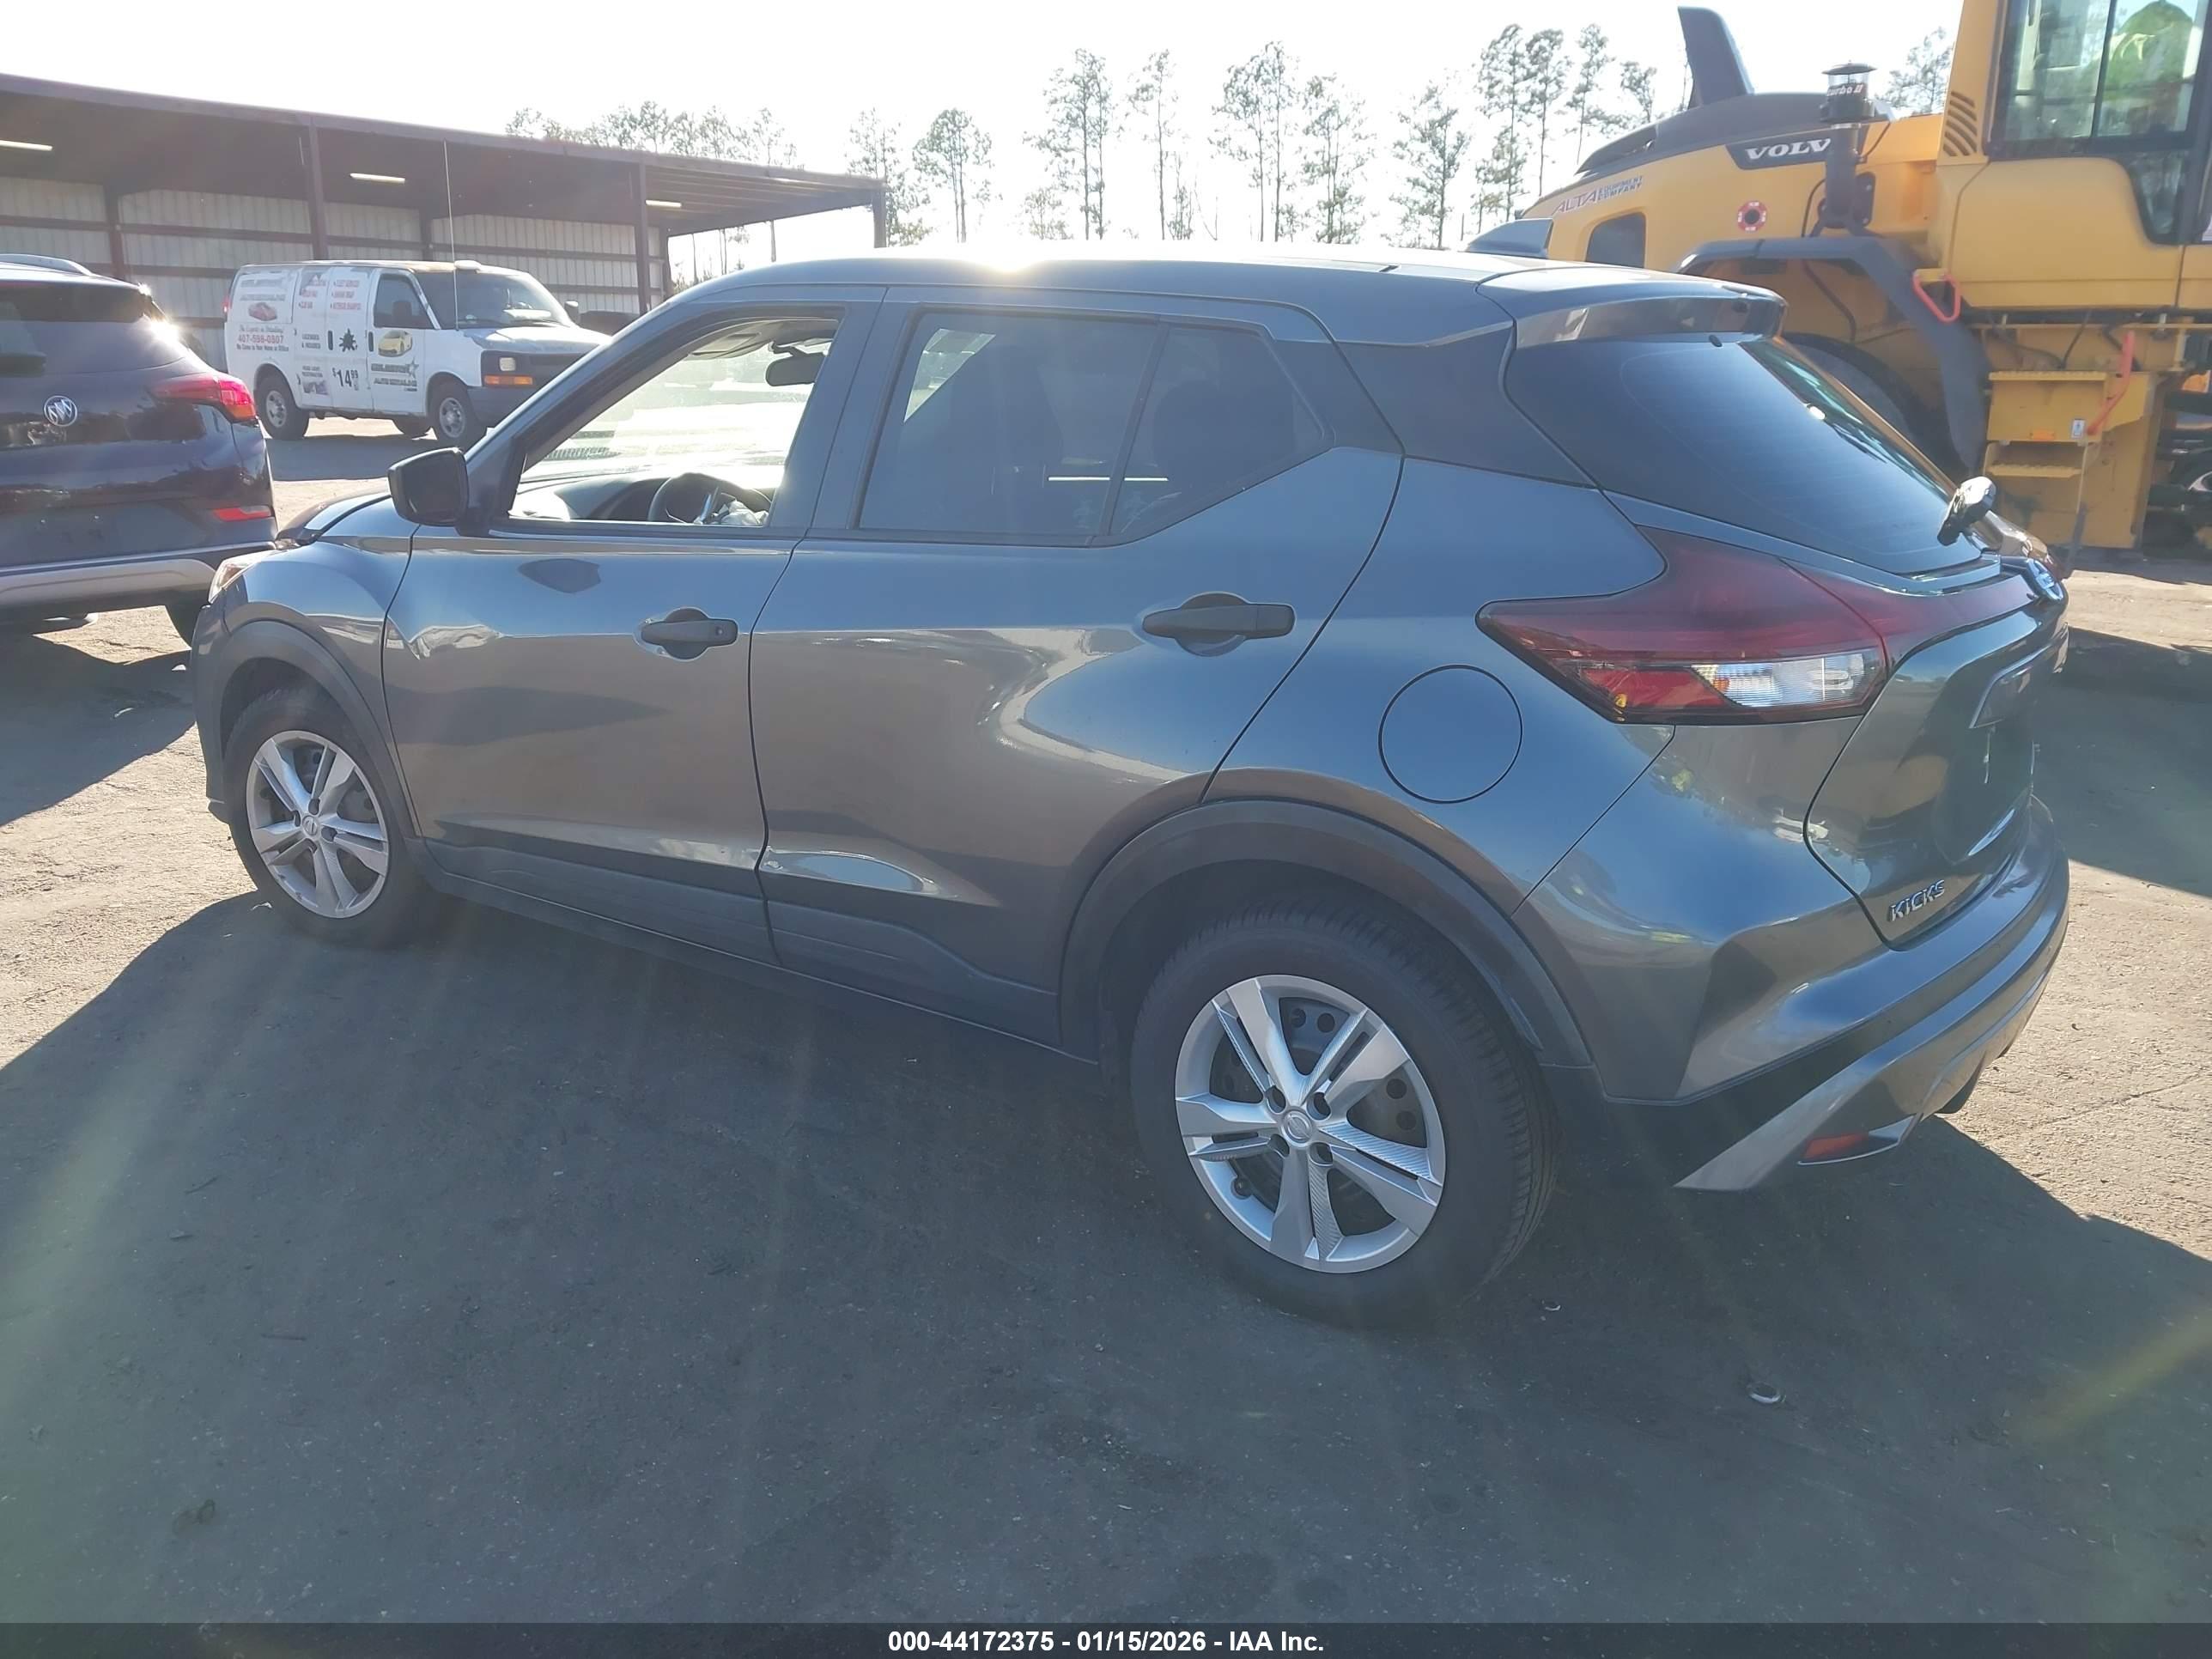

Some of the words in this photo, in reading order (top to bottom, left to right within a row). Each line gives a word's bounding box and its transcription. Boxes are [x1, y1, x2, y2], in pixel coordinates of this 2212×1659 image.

[1745, 138, 1832, 160] VOLV
[1552, 189, 1596, 215] ALTA
[1887, 879, 1945, 921] KICKS
